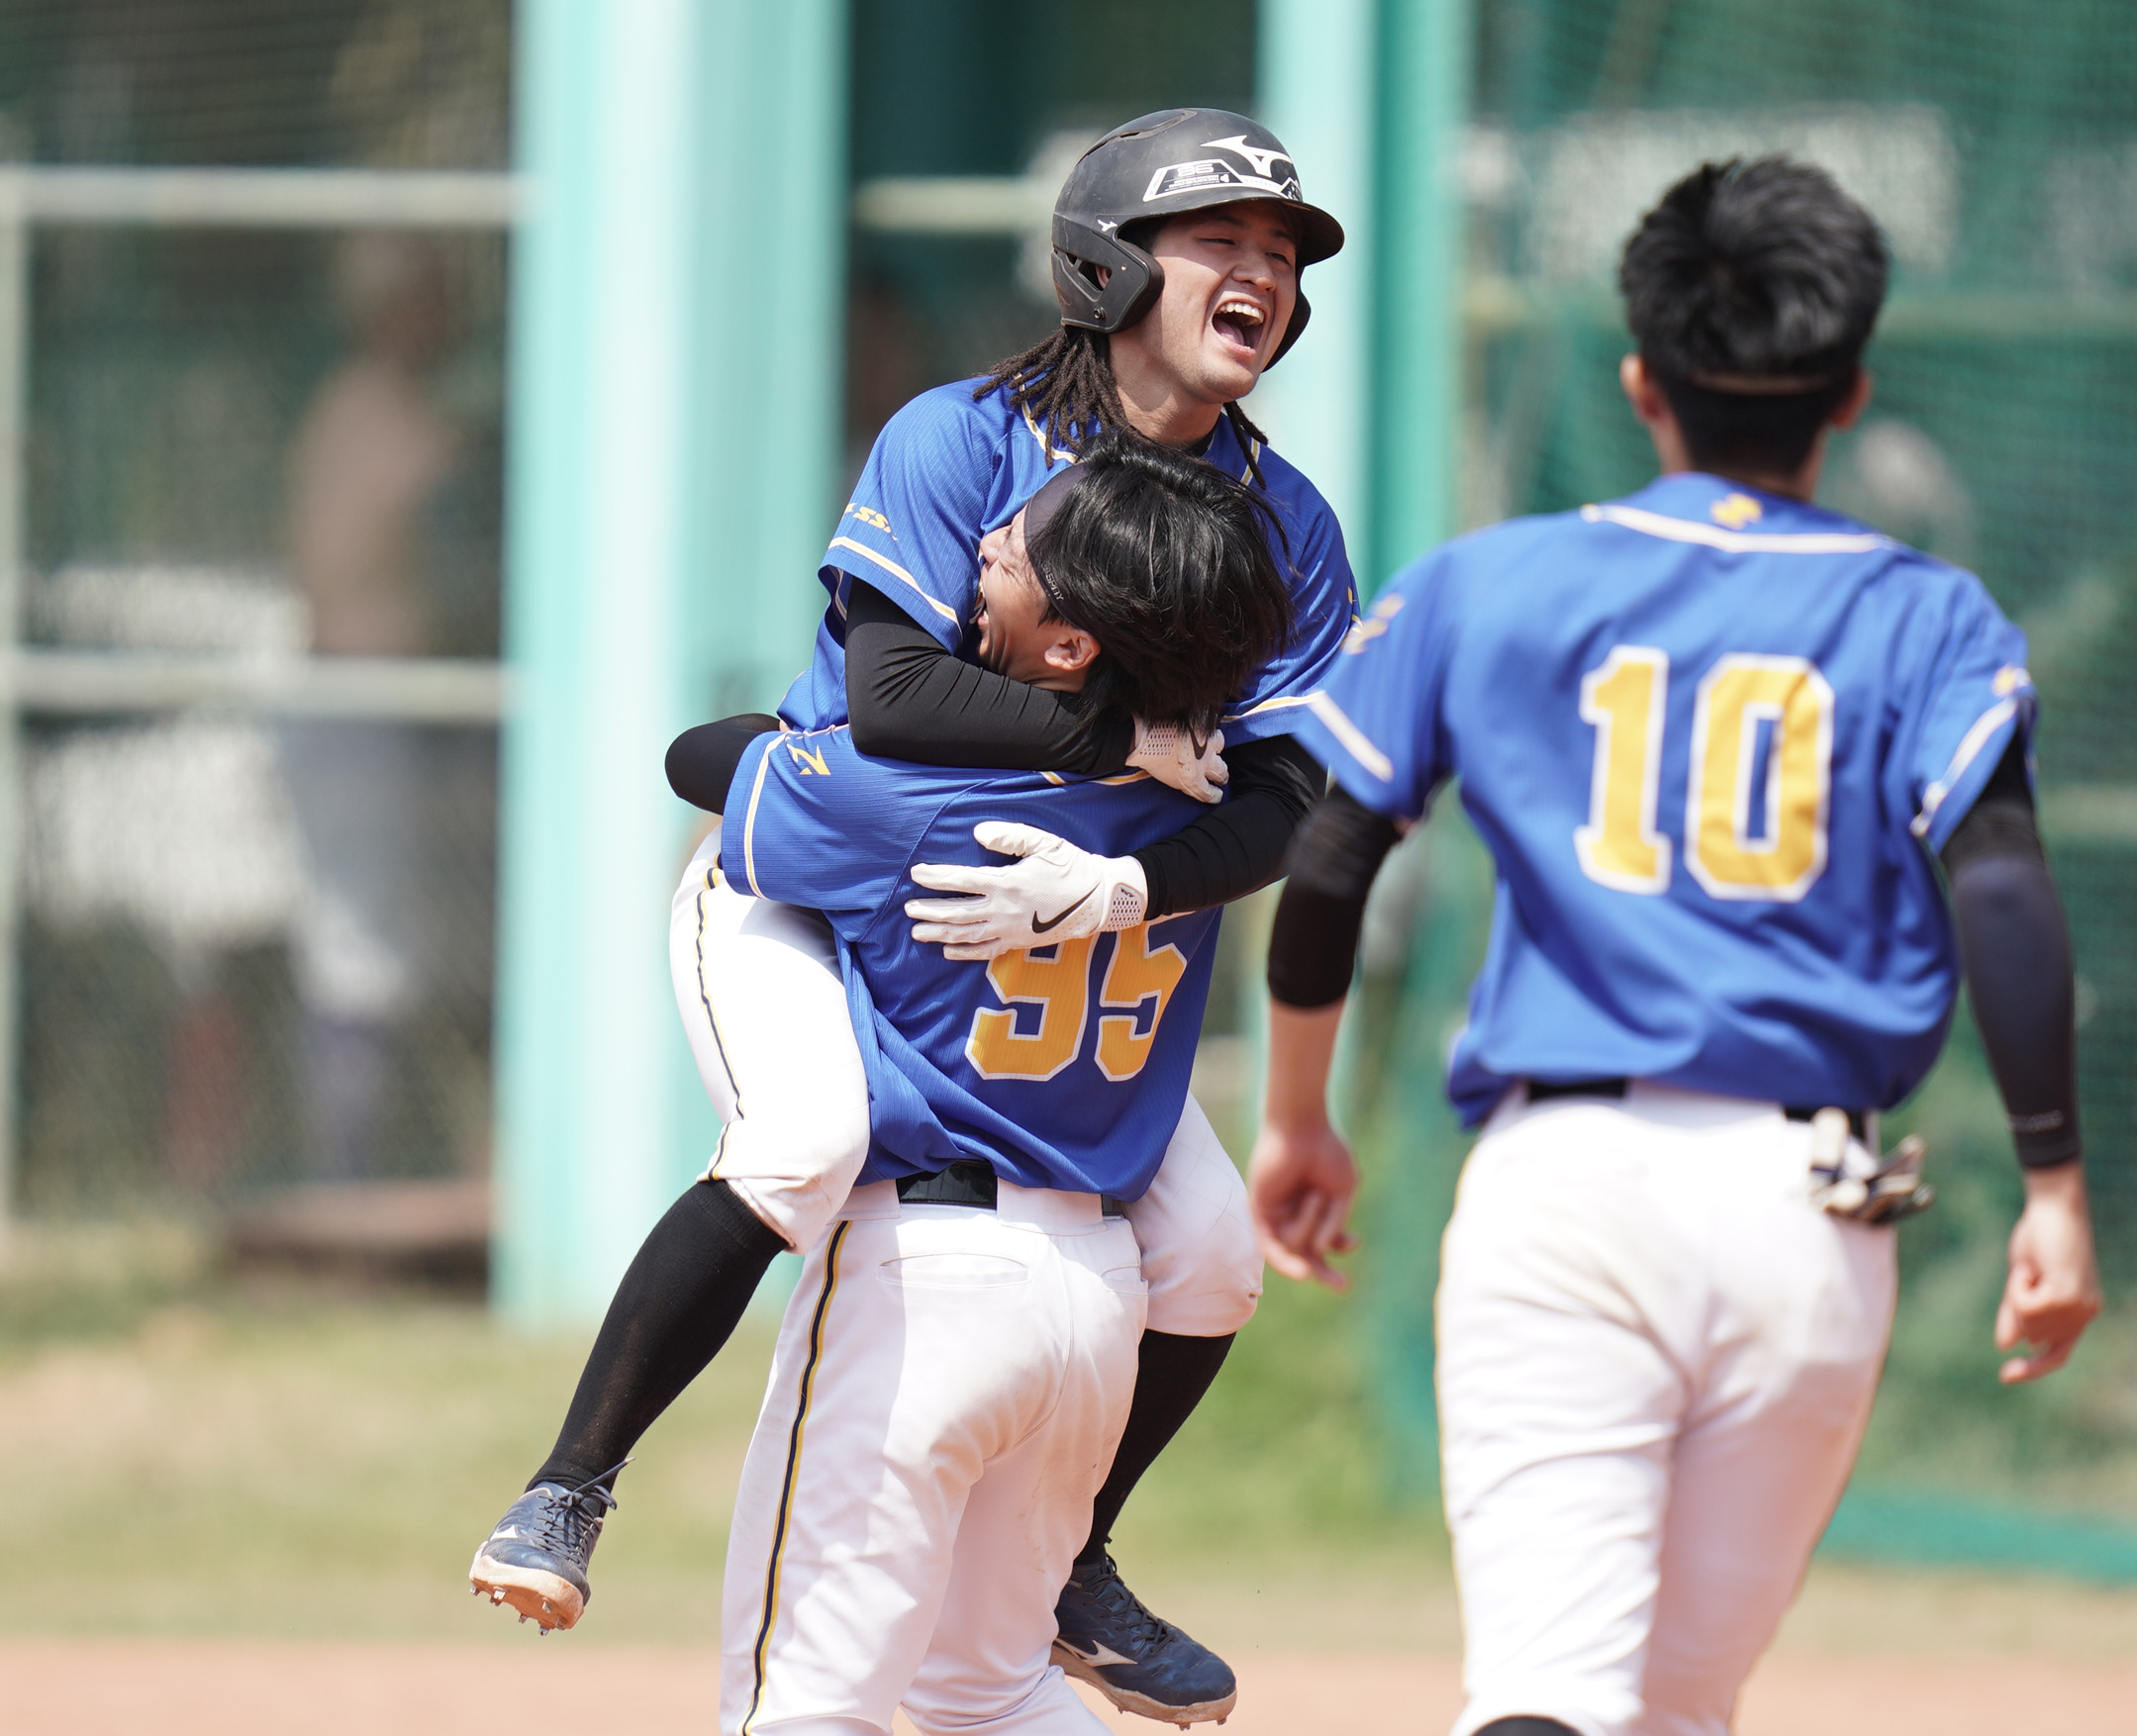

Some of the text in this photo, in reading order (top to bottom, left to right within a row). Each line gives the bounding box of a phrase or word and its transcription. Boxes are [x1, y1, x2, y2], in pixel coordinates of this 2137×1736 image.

[852, 506, 898, 541] SS
[1575, 644, 1834, 902] 10
[964, 911, 1194, 1082] 95
